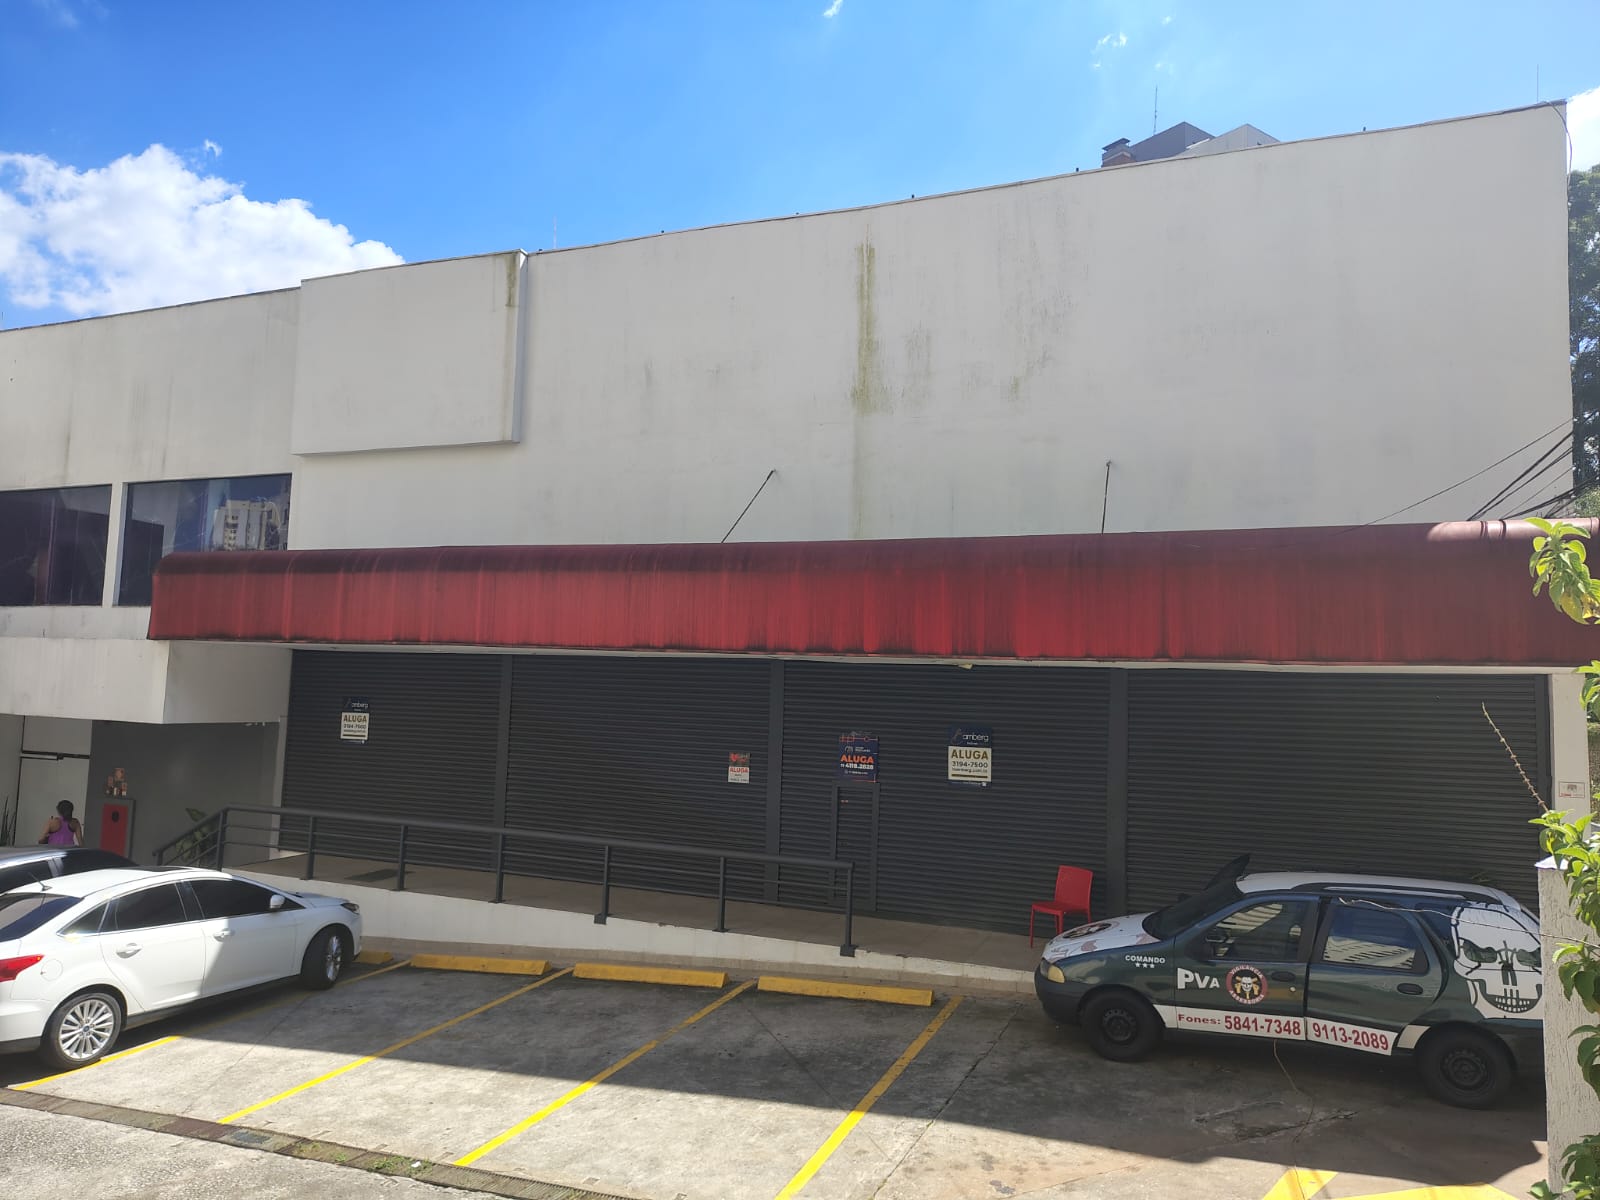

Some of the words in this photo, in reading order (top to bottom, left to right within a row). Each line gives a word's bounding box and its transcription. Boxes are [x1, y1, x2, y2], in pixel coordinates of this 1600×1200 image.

[344, 714, 367, 722] ALUGA
[840, 754, 874, 764] ALUGA
[951, 749, 989, 760] ALUGA
[951, 760, 989, 768] 3194-7500
[1125, 955, 1166, 964] COMANDO
[1178, 1013, 1221, 1025] Fones:
[1224, 1015, 1301, 1036] 5841-7348
[1312, 1022, 1389, 1051] 9113-2089
